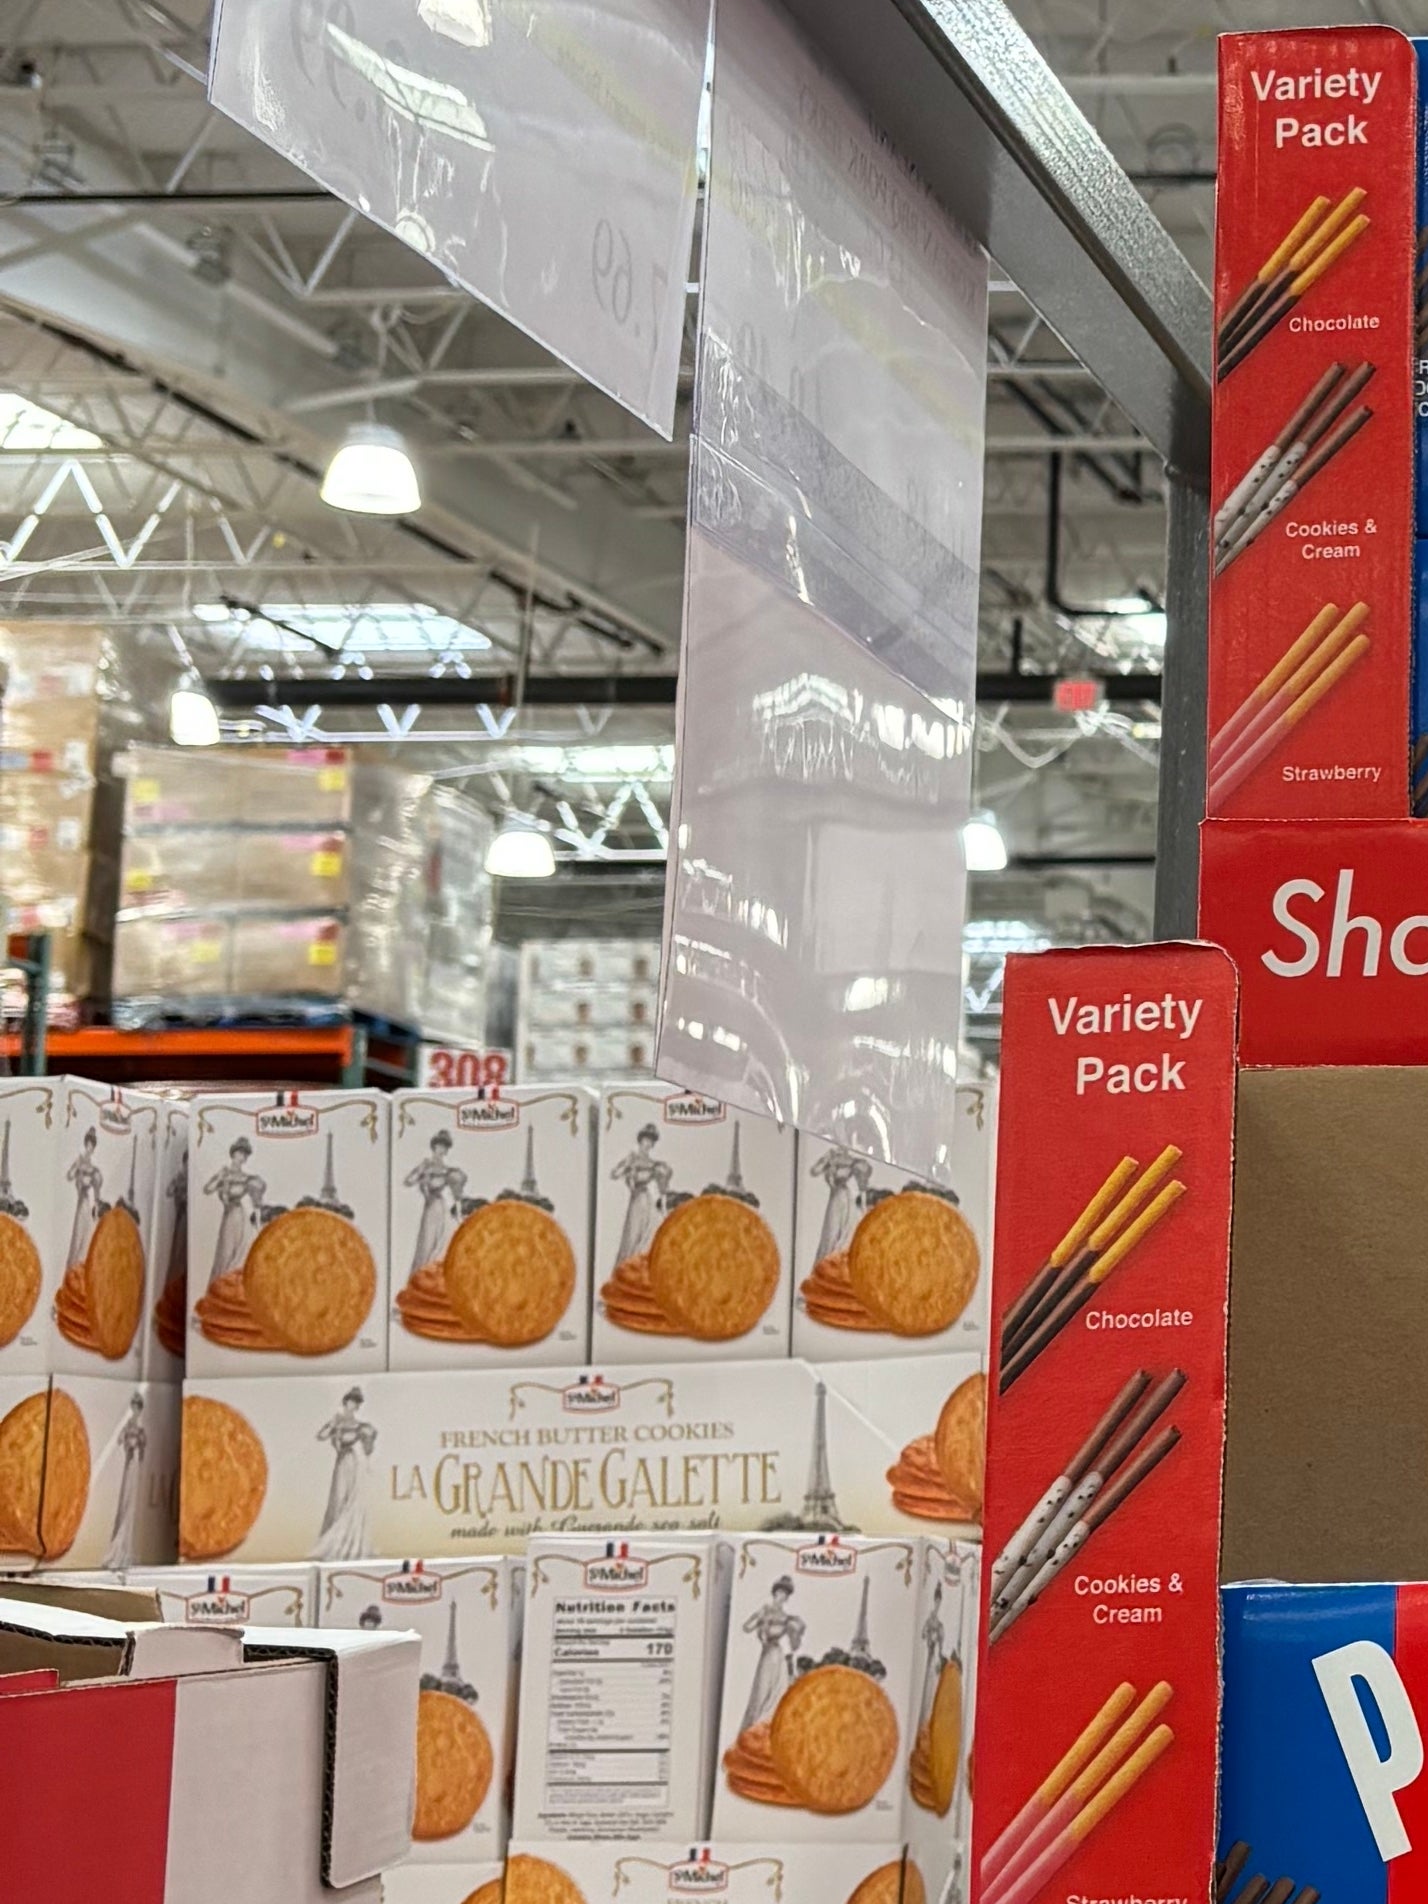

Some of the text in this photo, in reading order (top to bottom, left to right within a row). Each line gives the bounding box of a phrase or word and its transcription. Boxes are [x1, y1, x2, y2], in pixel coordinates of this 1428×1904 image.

[1250, 68, 1382, 104] Variety
[1275, 116, 1368, 148] Pack
[1049, 993, 1202, 1039] Variety
[1076, 1053, 1187, 1095] Pack
[1085, 1309, 1193, 1330] Chocolate
[441, 1421, 735, 1449] FRENCH BUTTER COOKIES
[390, 1463, 427, 1501] LA
[1074, 1573, 1183, 1595] Cookies &
[1092, 1603, 1163, 1624] Cream
